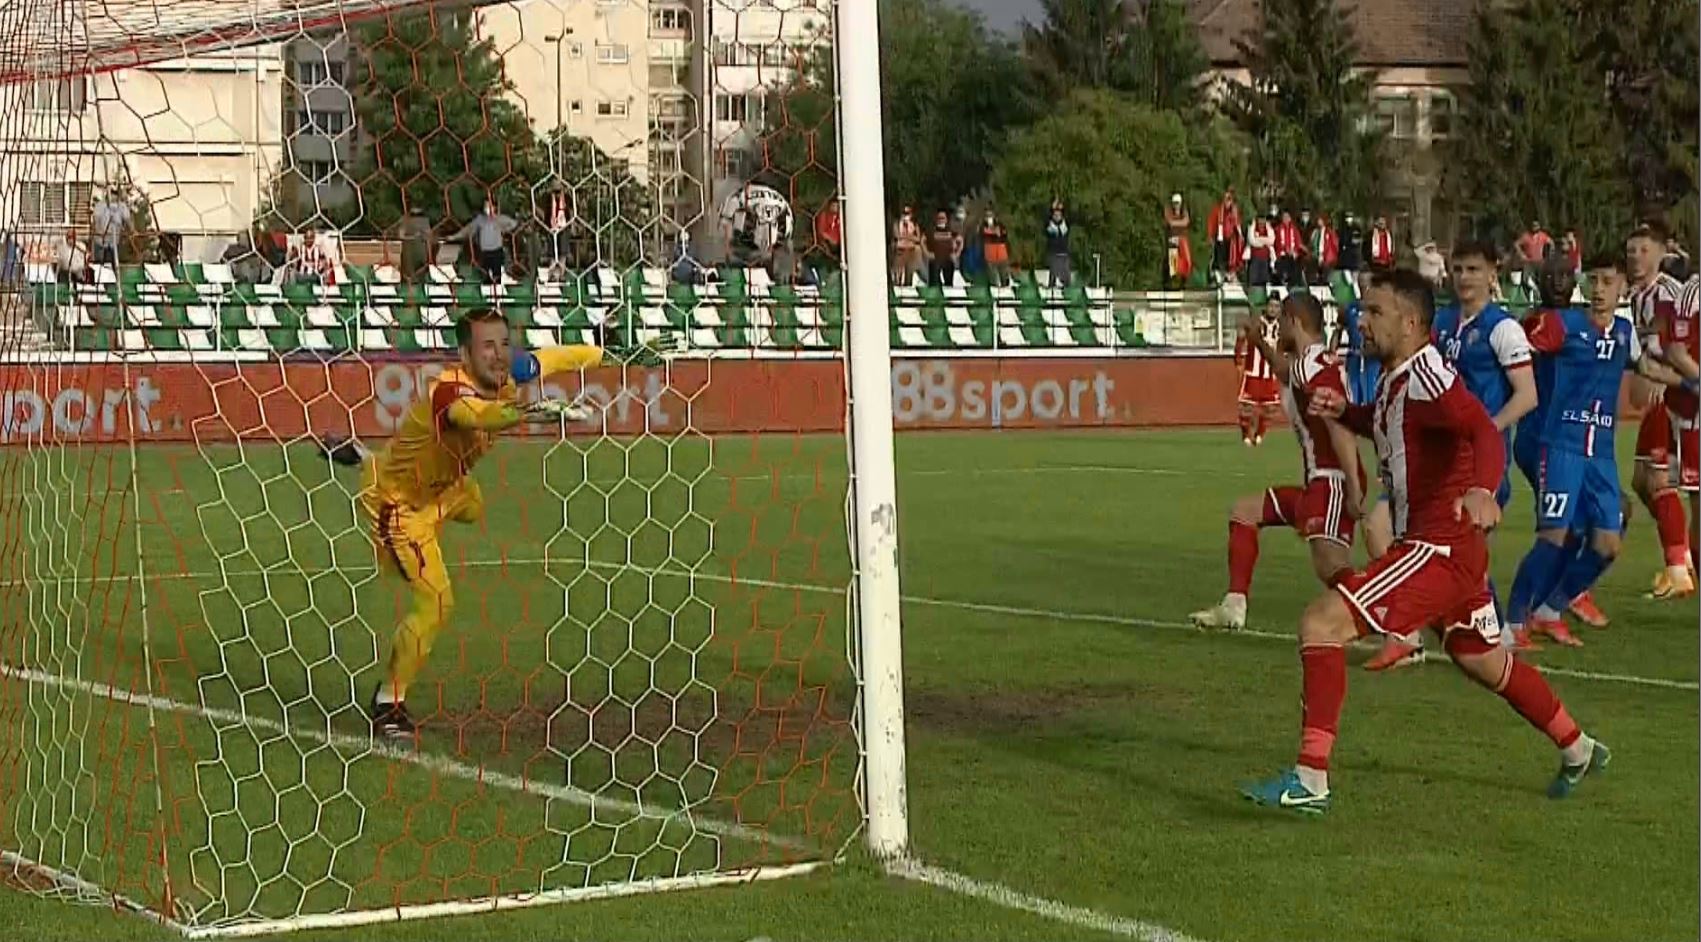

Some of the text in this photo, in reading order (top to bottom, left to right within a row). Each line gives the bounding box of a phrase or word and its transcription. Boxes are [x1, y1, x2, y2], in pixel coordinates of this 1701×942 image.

[1446, 338, 1461, 359] 20
[1596, 339, 1616, 360] 27
[1544, 493, 1569, 518] 27
